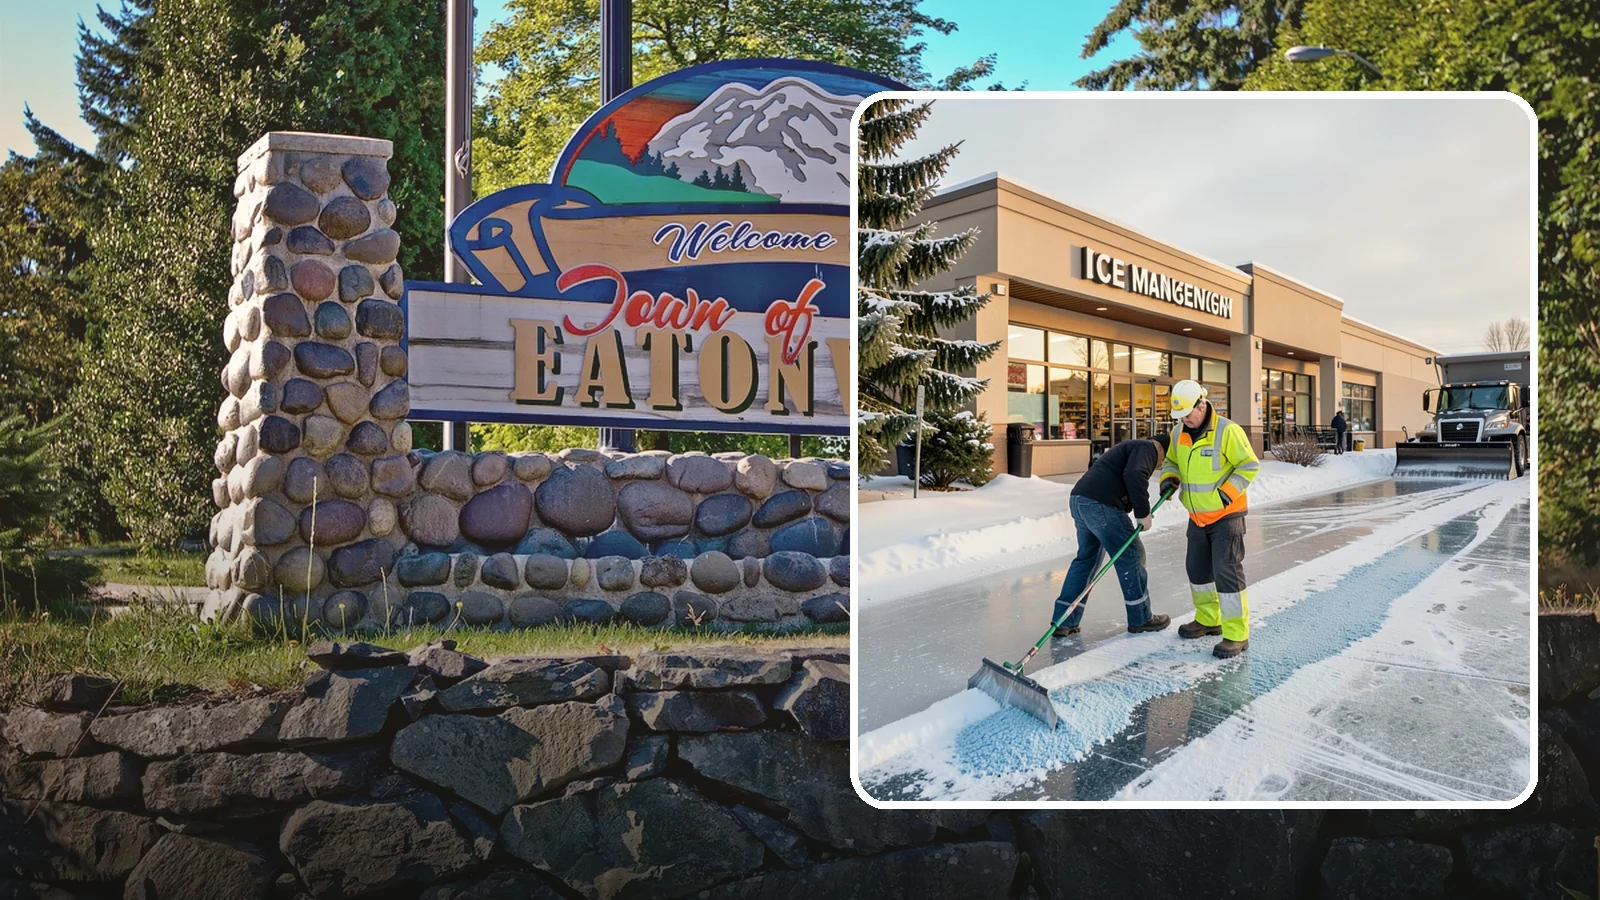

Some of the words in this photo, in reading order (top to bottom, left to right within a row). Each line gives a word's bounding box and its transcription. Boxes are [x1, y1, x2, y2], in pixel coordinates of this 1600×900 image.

[653, 220, 838, 264] Welcome
[1083, 246, 1125, 289] ICE
[557, 263, 737, 336] Town
[764, 278, 825, 366] of
